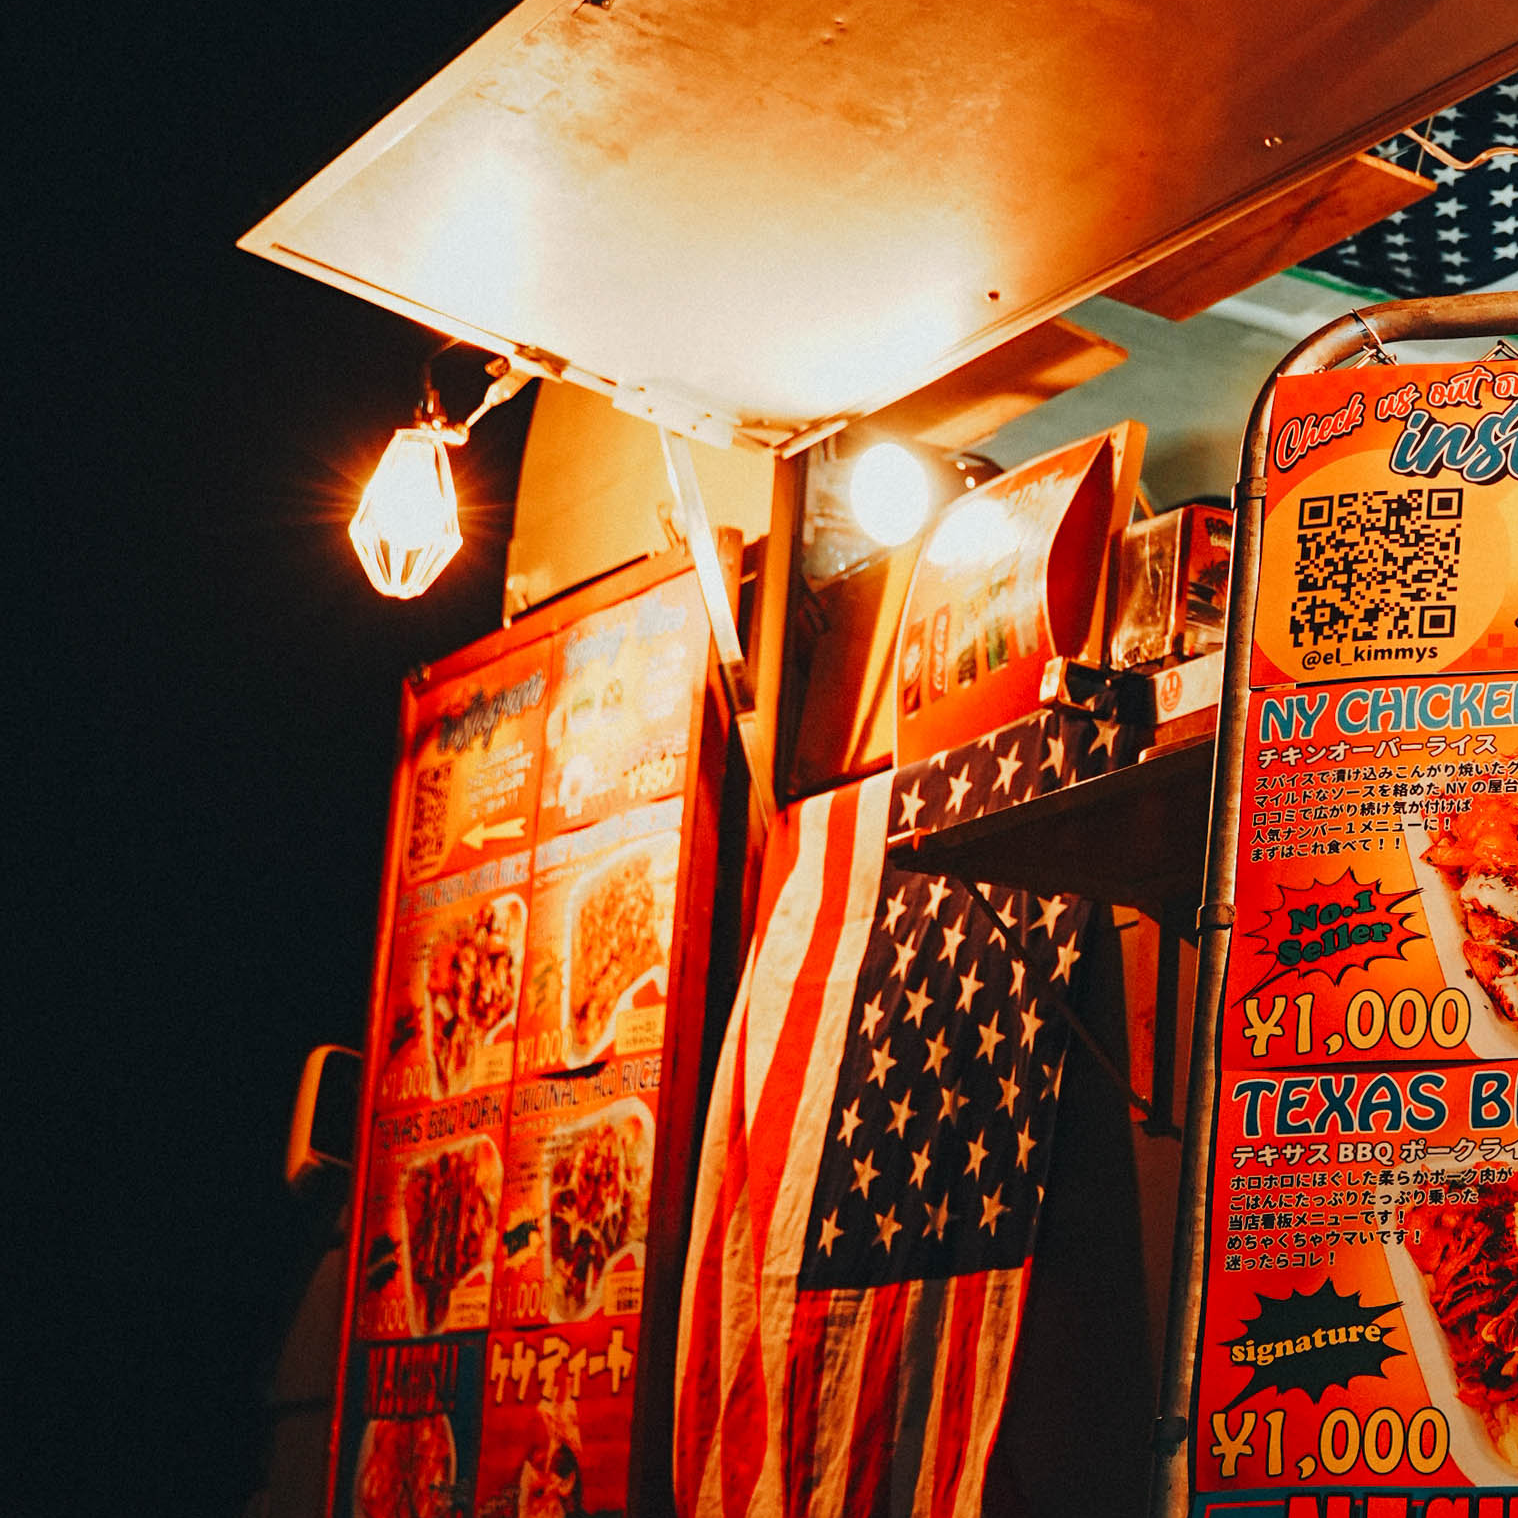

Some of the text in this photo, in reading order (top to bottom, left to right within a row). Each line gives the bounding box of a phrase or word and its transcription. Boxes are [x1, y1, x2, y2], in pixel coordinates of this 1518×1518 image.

[1274, 393, 1363, 470] Check
[1374, 384, 1417, 423] us
[1428, 366, 1483, 408] out
[1301, 645, 1439, 670] @el_kimmys
[1260, 694, 1332, 743] NY
[1259, 735, 1497, 769] チキンオーバーライス
[1253, 798, 1472, 827] 口コミで広がり続け気が付けば
[1288, 890, 1376, 935] No.1
[1277, 922, 1393, 966] Seller
[1243, 987, 1471, 1058] ¥1,000
[1232, 1072, 1448, 1139] TEXAS
[1232, 1143, 1330, 1168] テキサス
[1338, 1143, 1394, 1165] BBQ
[1230, 1189, 1479, 1211] ごはんにたっぷりたっぷり乗った
[1231, 1321, 1382, 1367] signature
[1210, 1406, 1450, 1480] ¥1,000
